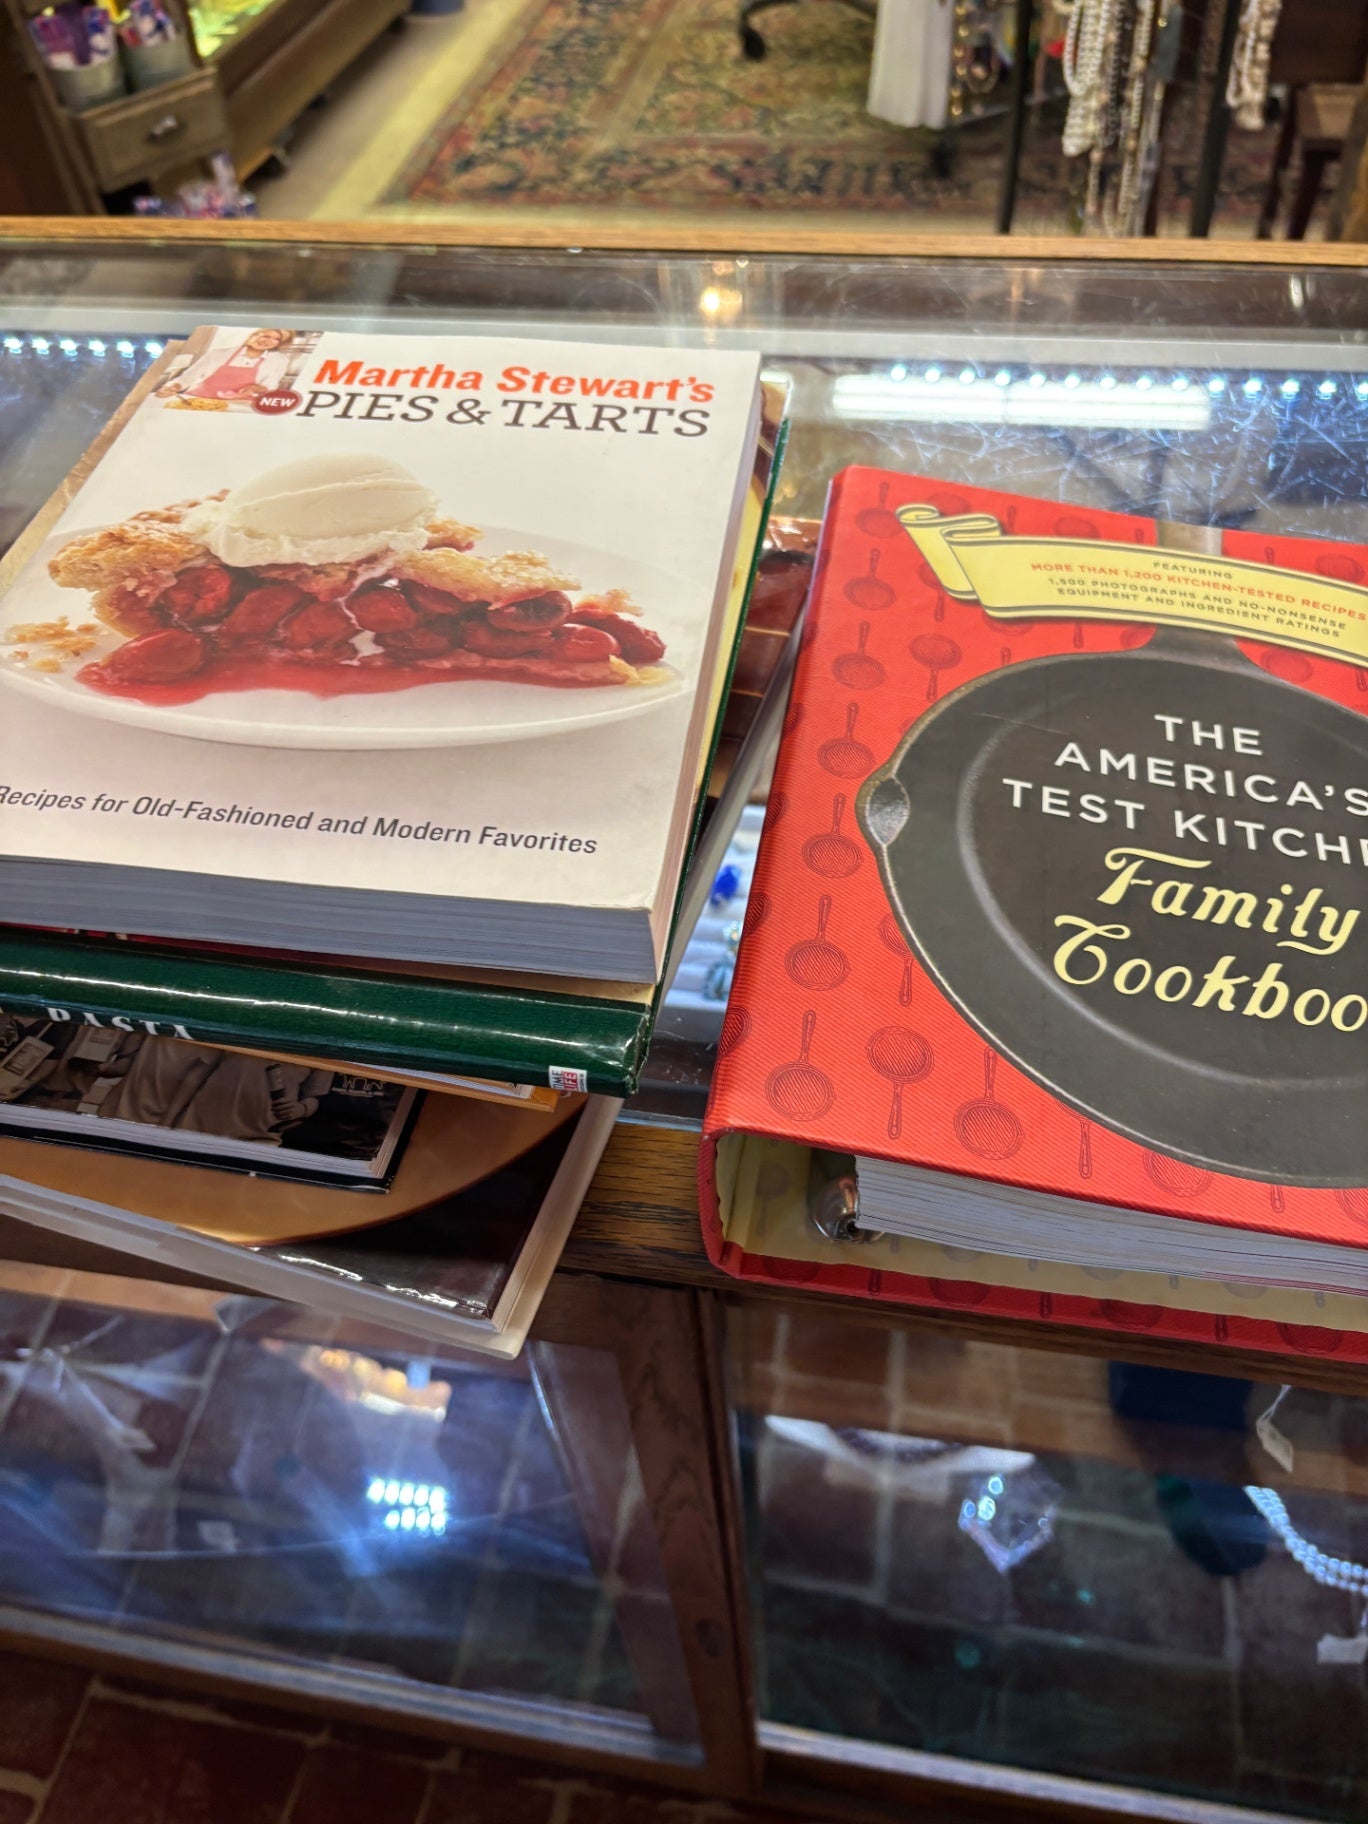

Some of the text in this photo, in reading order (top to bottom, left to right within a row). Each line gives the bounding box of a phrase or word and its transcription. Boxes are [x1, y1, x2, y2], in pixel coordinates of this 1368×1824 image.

[259, 394, 296, 410] NEW
[313, 359, 715, 404] Martha Stewart's
[297, 390, 711, 438] PIES & TARTS
[1031, 562, 1367, 621] MORE THAN 1,200 KITCHEN-TESTED RECIPES
[1153, 561, 1233, 580] FEATURING
[1048, 577, 1347, 631] 1,500 PHOTOGRAPHS AND NO-NONSENSE
[1057, 587, 1341, 638] EQUIPMENT AND INGREDIENT RATINGS
[1154, 714, 1263, 756] THE
[1002, 778, 1145, 829] TEST
[1054, 742, 1368, 816] AMERICA'S
[0, 785, 598, 855] Recipes for Old-Fashioned and Modern Favorites
[1097, 846, 1361, 956] Family
